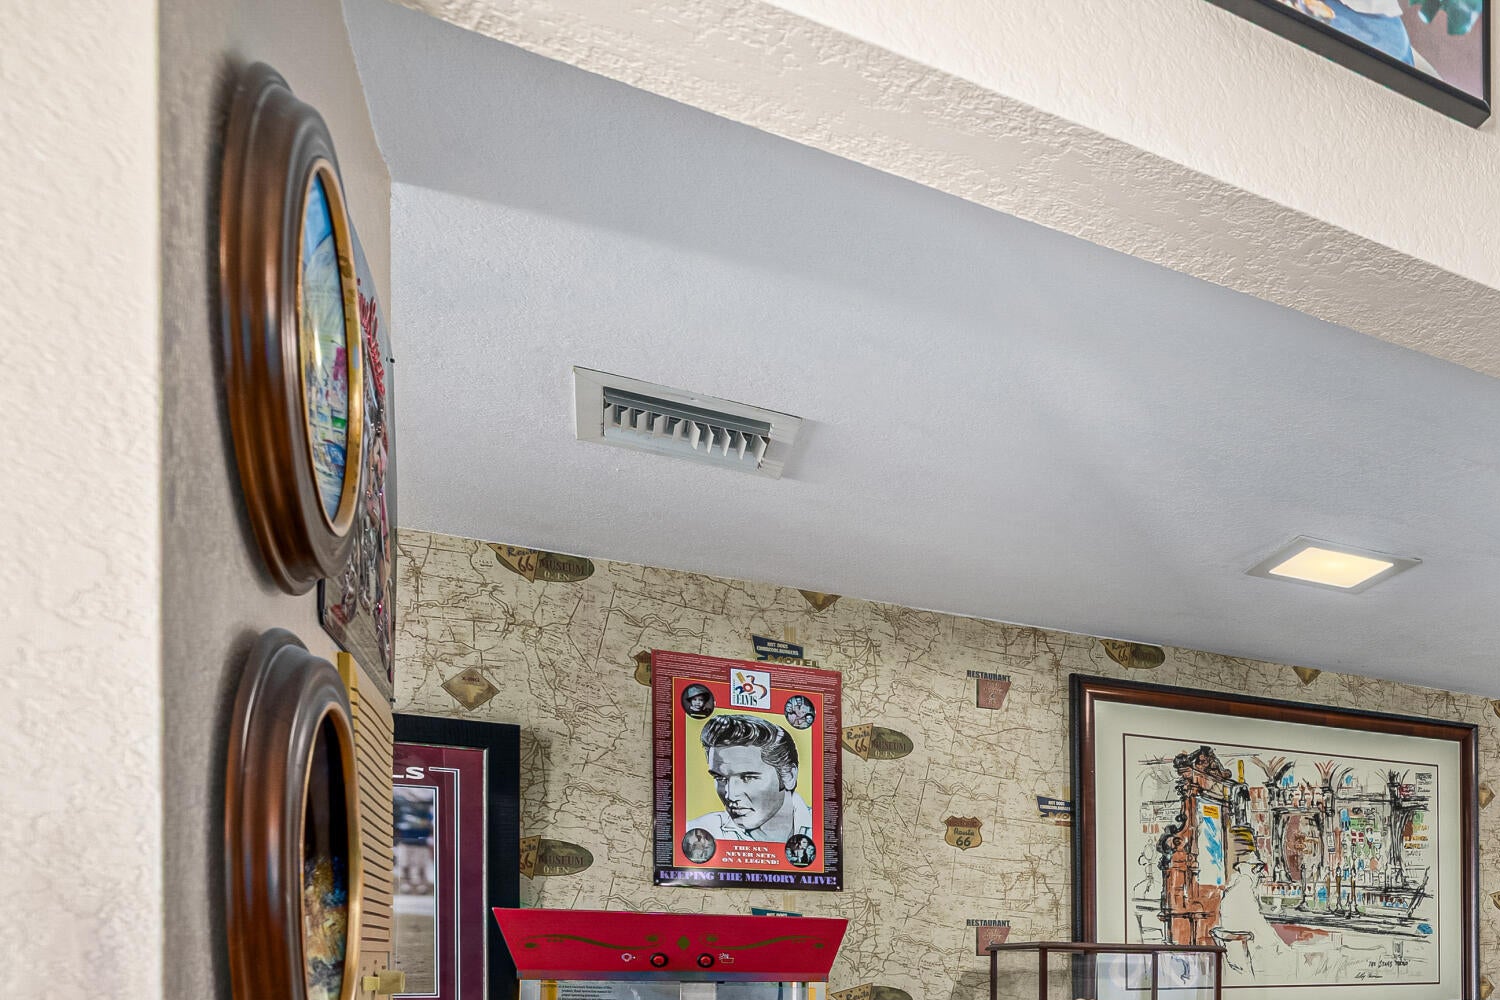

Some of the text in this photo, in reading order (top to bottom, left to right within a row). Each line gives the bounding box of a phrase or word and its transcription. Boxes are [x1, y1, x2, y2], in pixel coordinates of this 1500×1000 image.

[854, 739, 867, 753] 66
[956, 836, 970, 847] 66
[659, 870, 837, 886] KEEPING THE MEMORY ALIVE!
